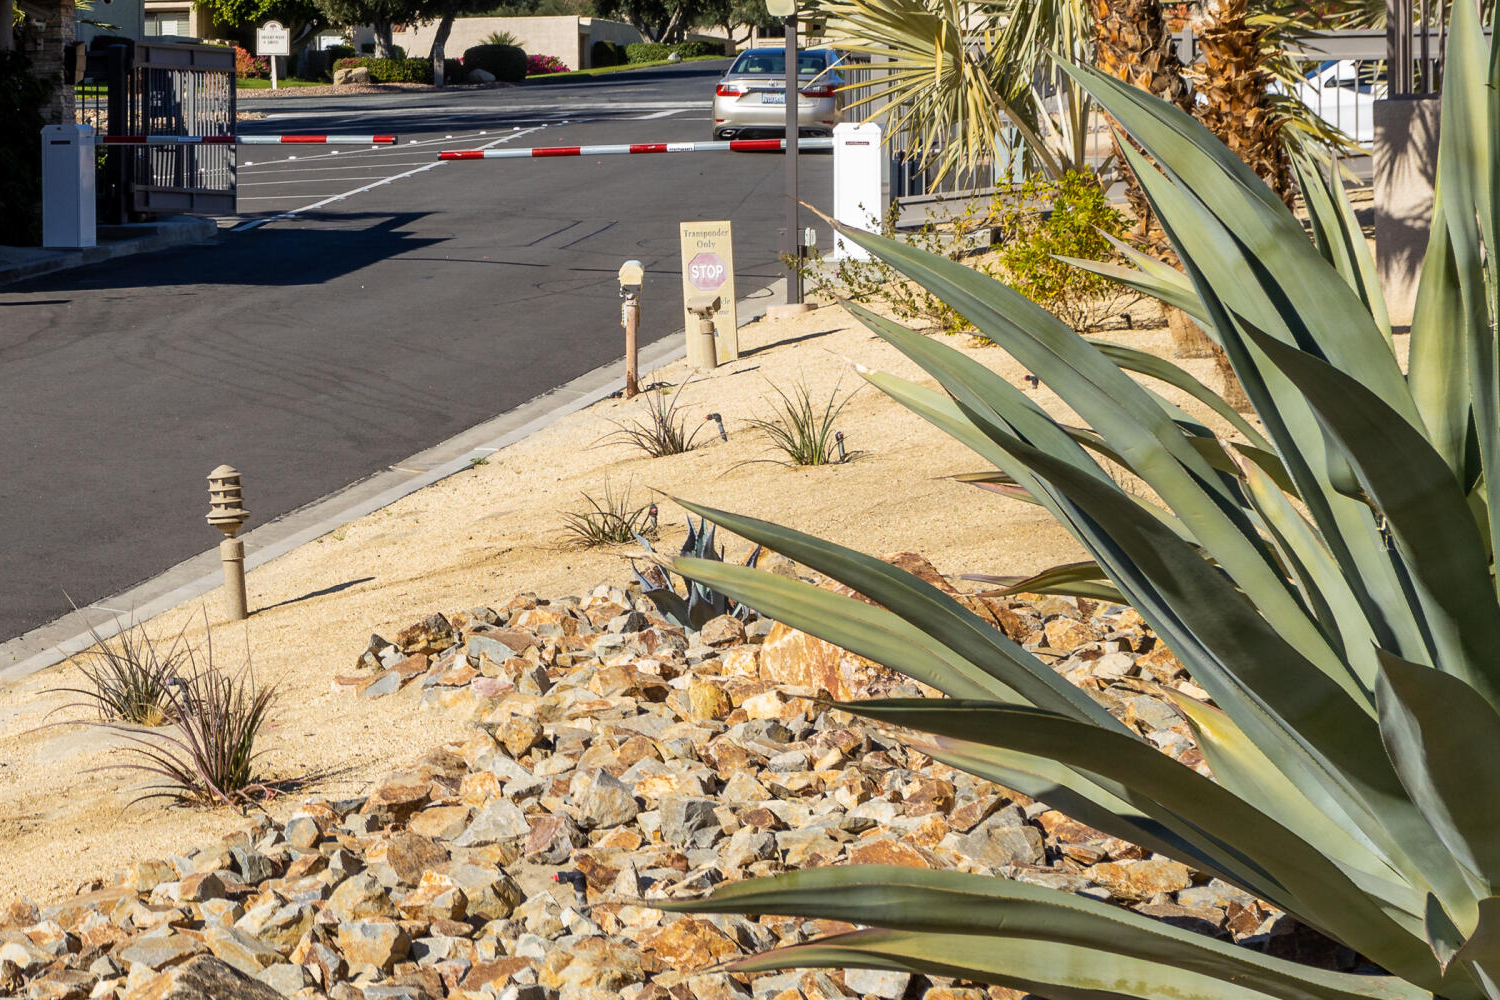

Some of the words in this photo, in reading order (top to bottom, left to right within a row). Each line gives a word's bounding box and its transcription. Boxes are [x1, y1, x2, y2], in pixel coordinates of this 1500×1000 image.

[683, 228, 729, 239] Transponder
[696, 240, 716, 249] Only
[691, 265, 724, 280] STOP
